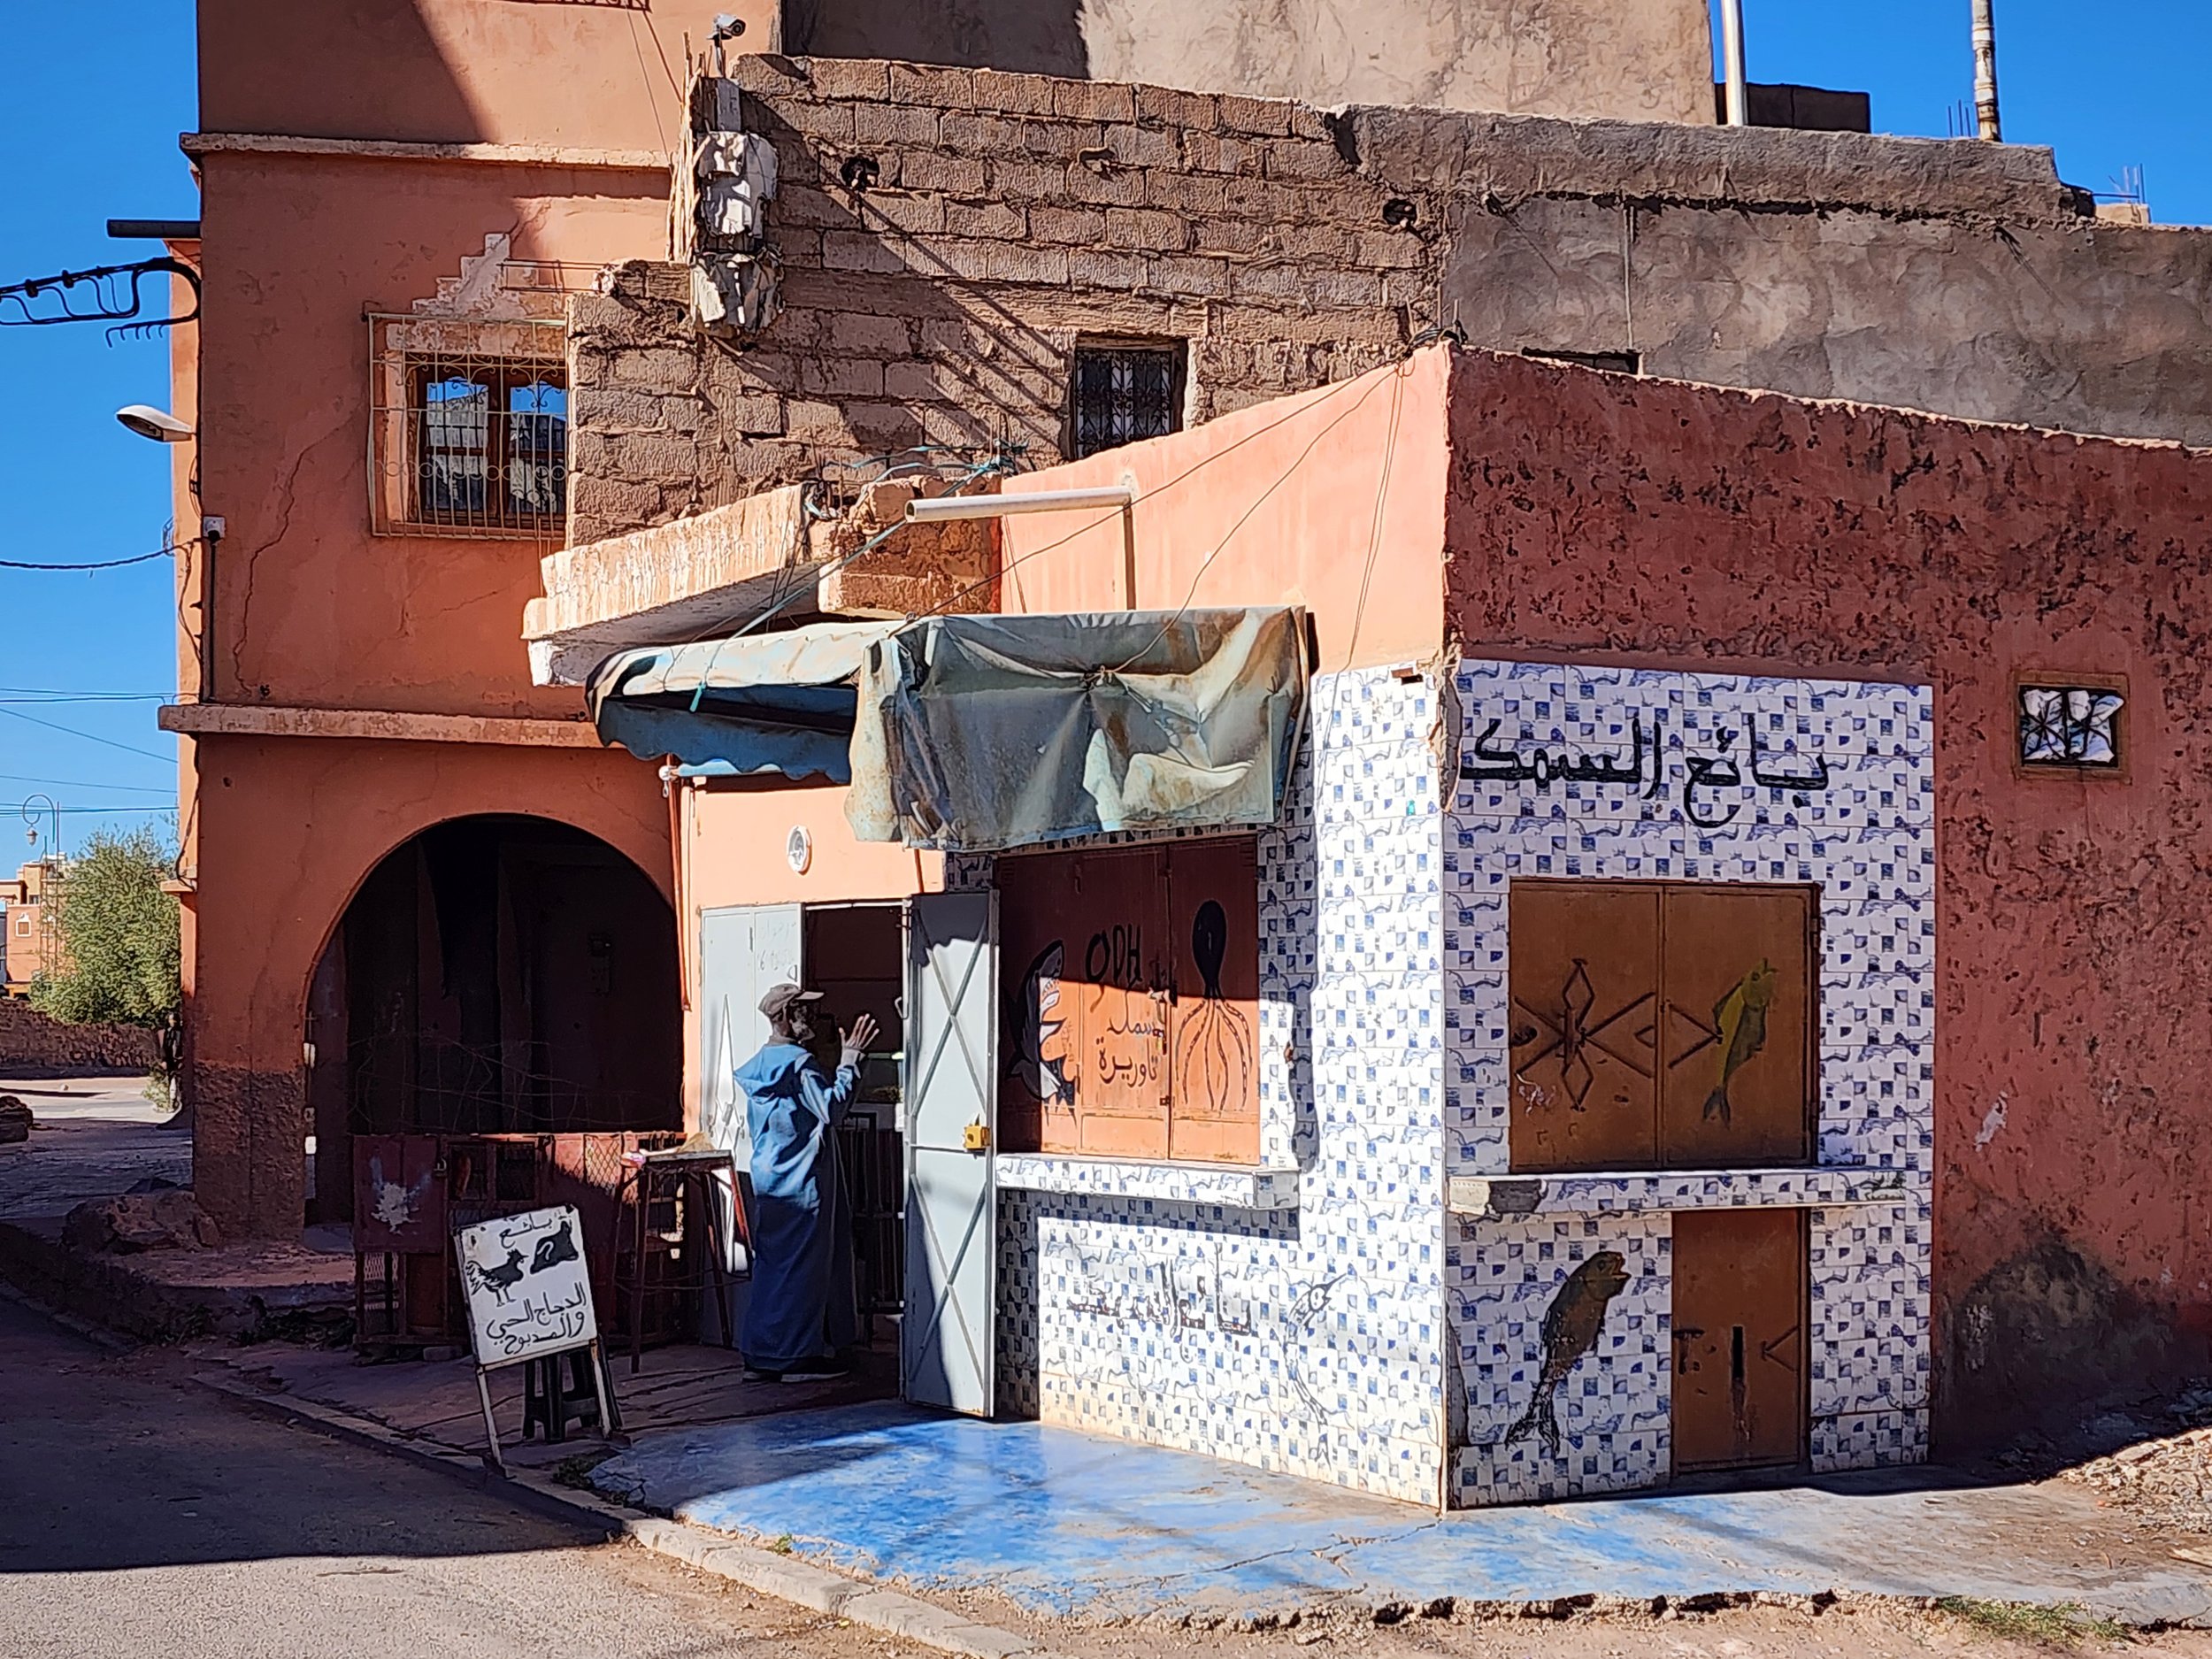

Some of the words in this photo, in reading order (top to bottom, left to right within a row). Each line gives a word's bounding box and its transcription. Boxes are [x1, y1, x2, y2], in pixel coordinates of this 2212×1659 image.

[1459, 714, 1662, 800] السمك
[1683, 713, 1829, 827] بائع
[499, 1212, 553, 1249] بائع
[486, 1298, 534, 1346] الحي
[534, 1281, 587, 1326] الدجاج
